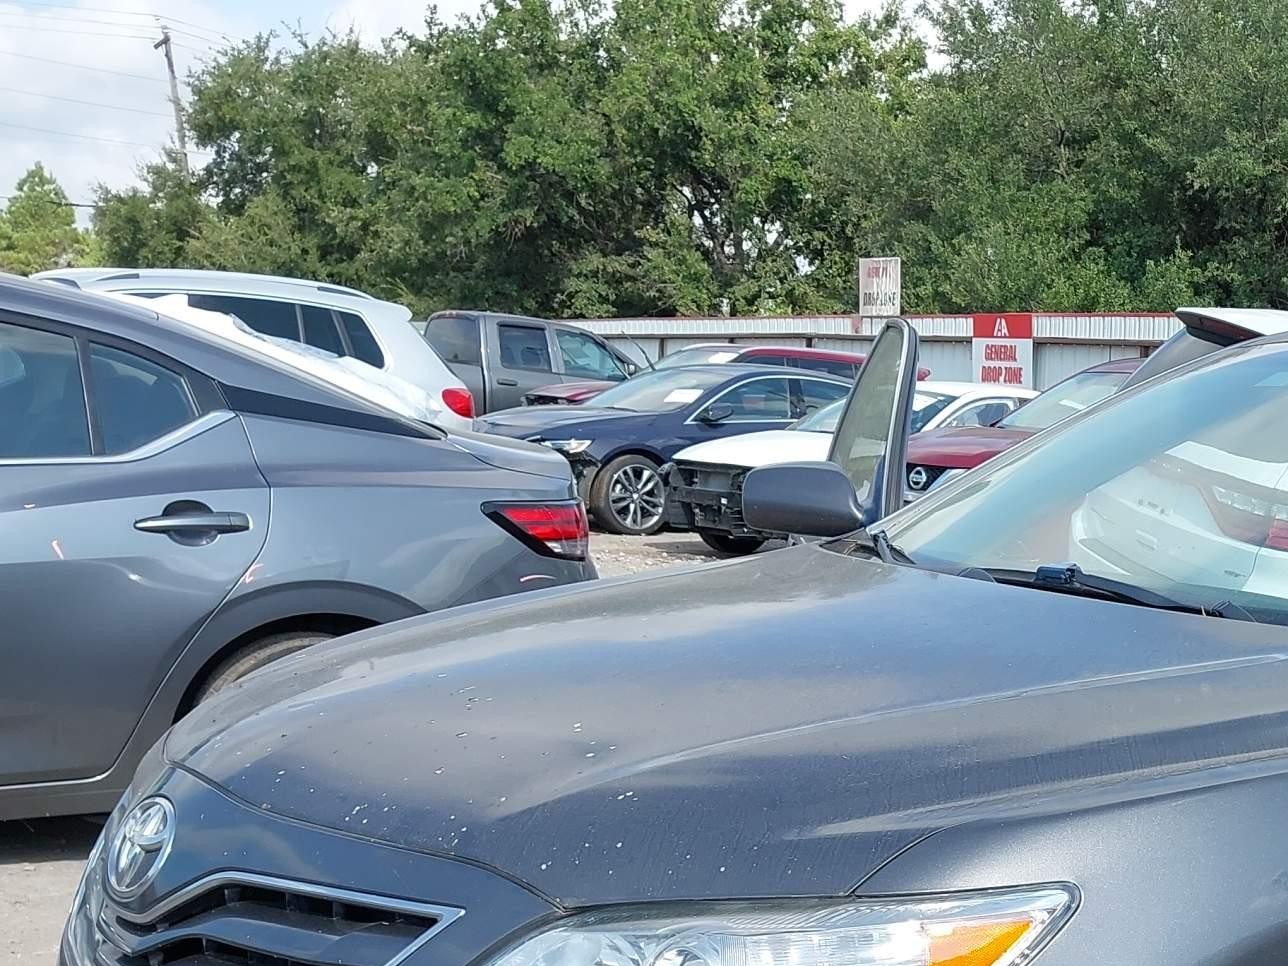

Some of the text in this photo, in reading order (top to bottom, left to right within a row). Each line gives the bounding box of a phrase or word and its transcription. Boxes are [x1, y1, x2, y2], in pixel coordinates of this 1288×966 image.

[984, 344, 1017, 362] GENERAL
[981, 366, 1023, 384] DROP ZONE
